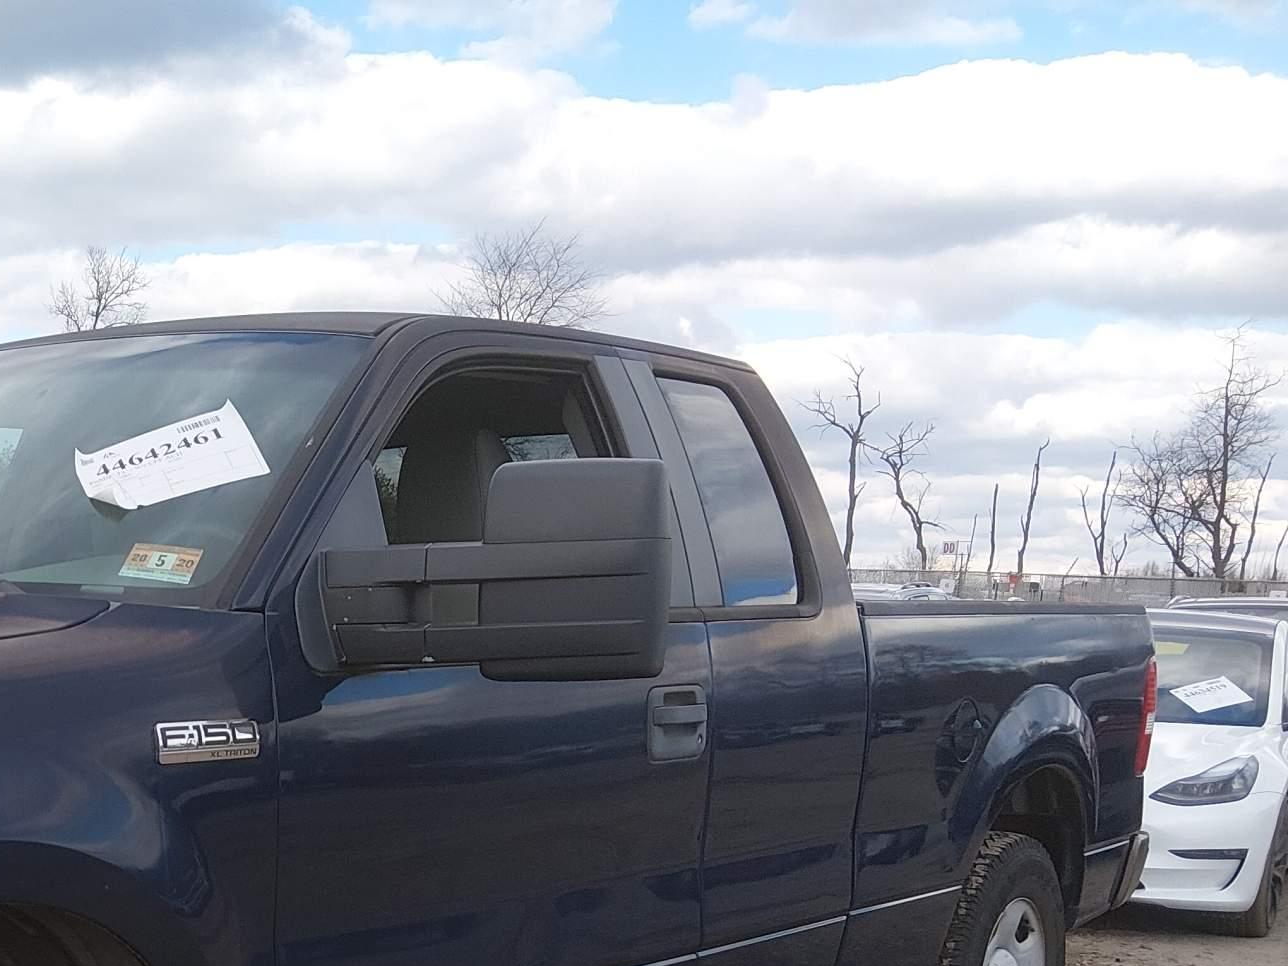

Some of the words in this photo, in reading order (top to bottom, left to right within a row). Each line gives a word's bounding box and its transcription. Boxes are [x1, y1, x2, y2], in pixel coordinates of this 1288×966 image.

[96, 427, 225, 477] 44642461
[131, 553, 148, 563] 20
[154, 554, 168, 568] 5
[175, 558, 195, 569] 20
[225, 748, 257, 757] TRITON
